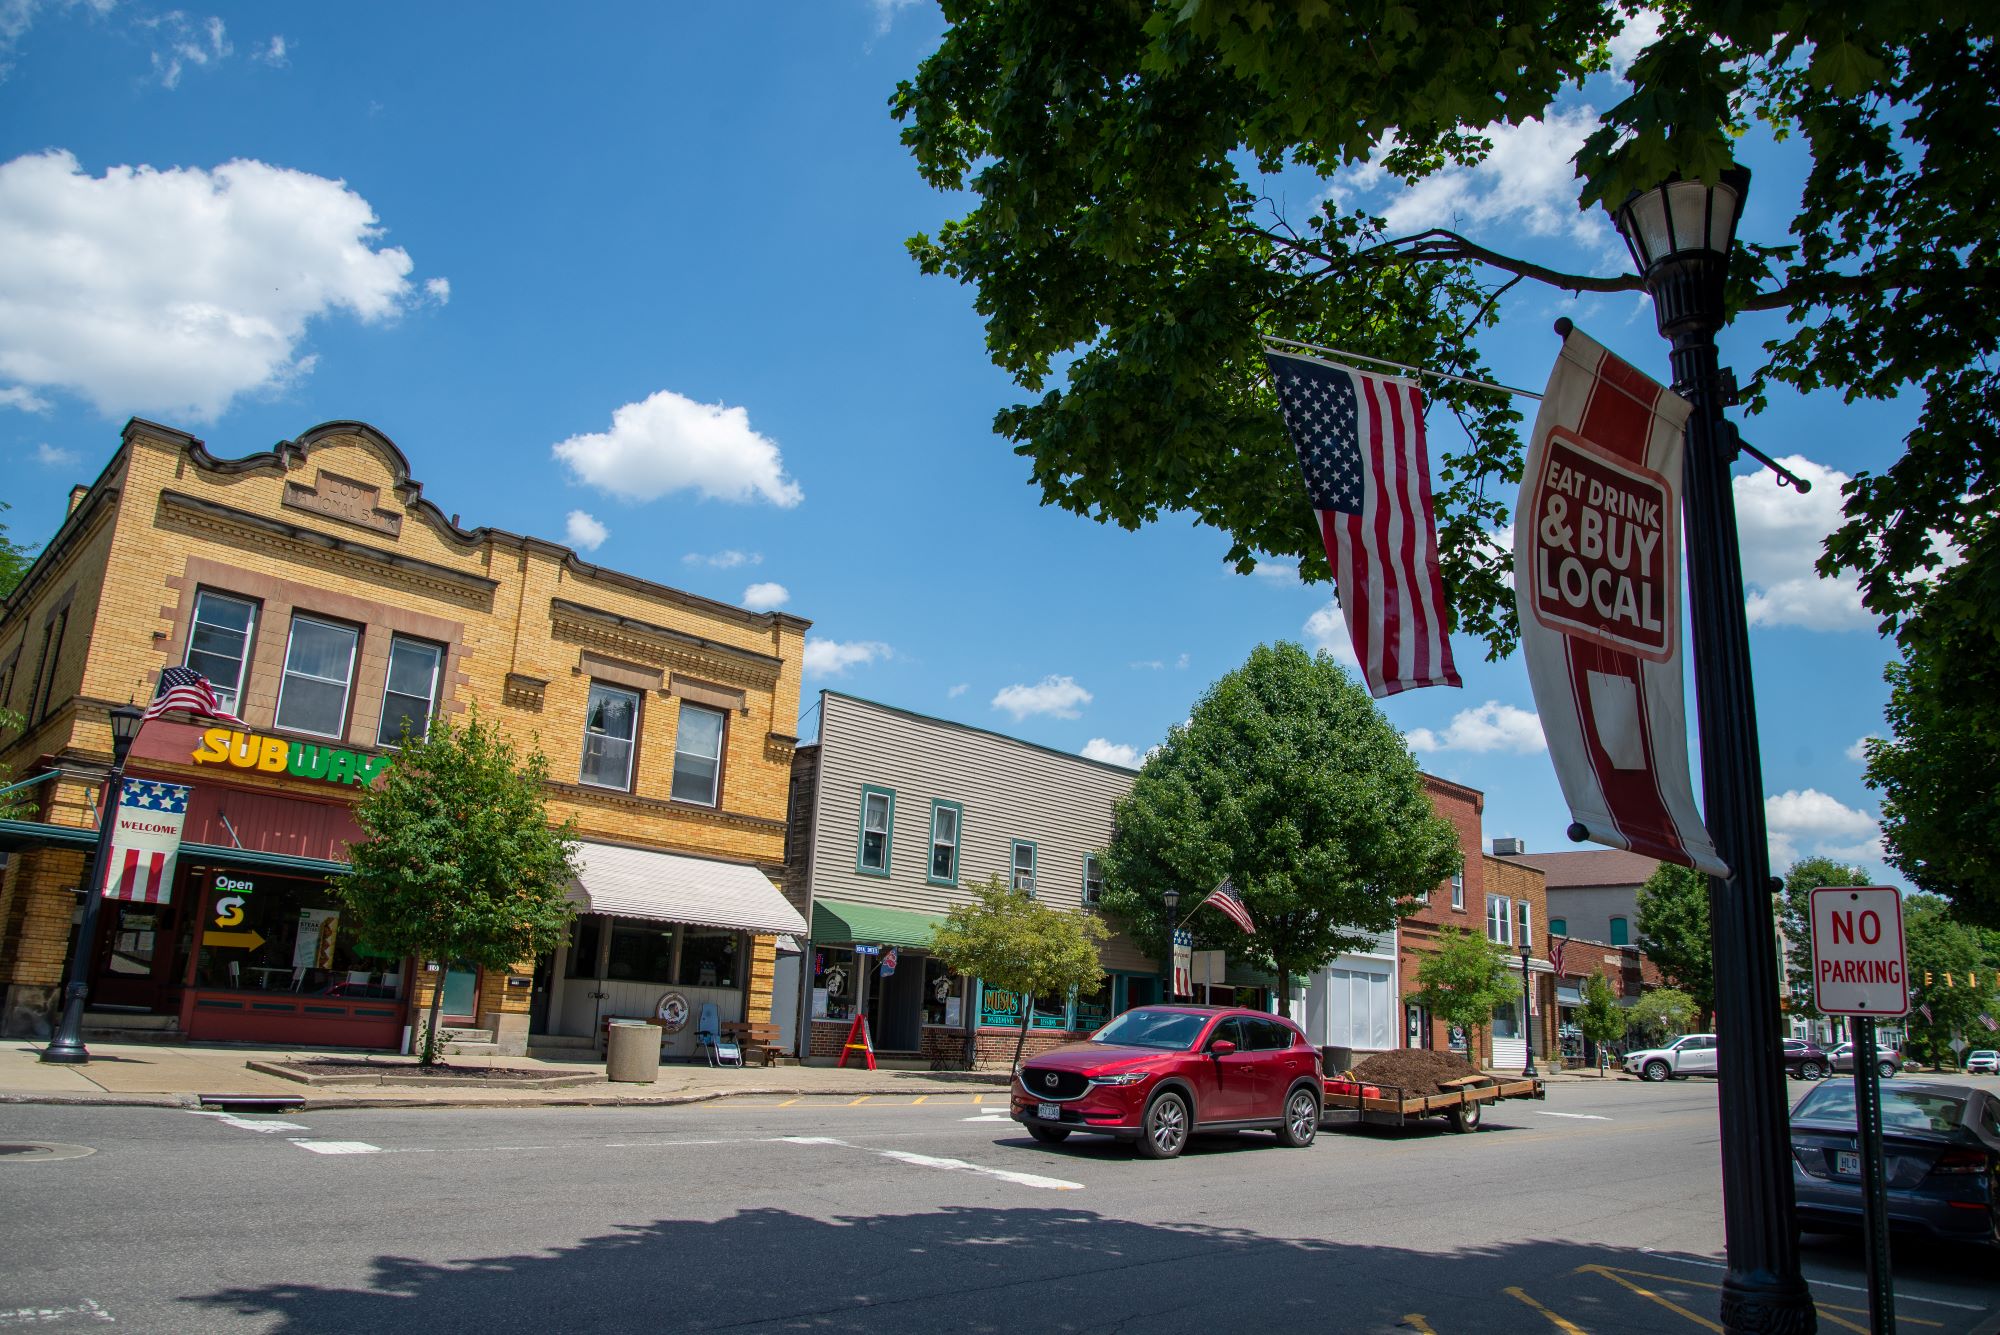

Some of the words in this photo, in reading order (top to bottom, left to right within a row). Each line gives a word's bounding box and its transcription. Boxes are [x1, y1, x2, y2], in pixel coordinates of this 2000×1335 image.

[329, 480, 368, 501] LODI
[1547, 460, 1587, 499] EAT
[1589, 478, 1660, 530] DRINK
[1541, 494, 1576, 554] &
[1581, 505, 1661, 576] BUY
[1539, 547, 1662, 632] LOCAL
[192, 728, 393, 787] SUBWAY
[121, 820, 177, 835] WELCOME
[216, 876, 253, 891] Open
[1831, 910, 1881, 945] NO
[1820, 960, 1900, 984] PARKING
[984, 989, 1020, 1014] MUSIC
